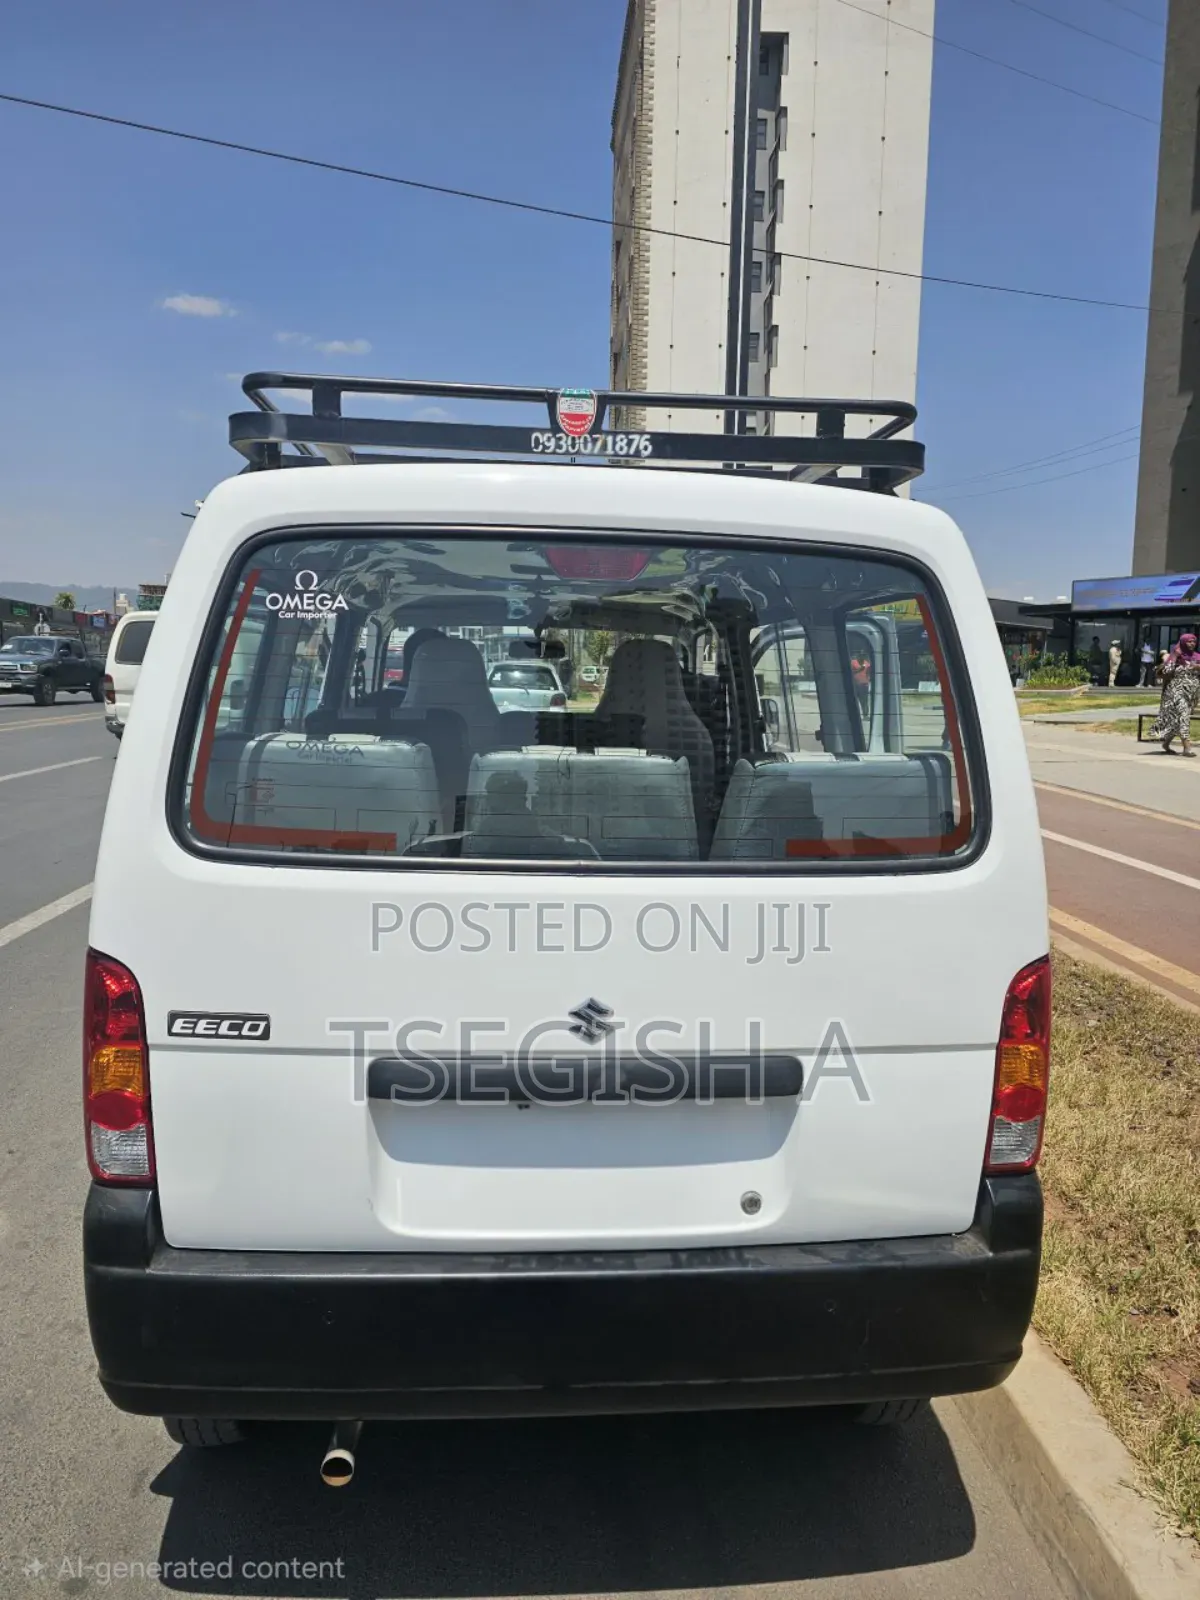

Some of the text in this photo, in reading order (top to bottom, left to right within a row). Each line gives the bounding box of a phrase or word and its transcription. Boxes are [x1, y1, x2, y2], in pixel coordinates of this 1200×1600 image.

[531, 432, 653, 457] 0930071876
[265, 592, 350, 611] OMEGA
[278, 610, 337, 620] Car Importer
[171, 1018, 268, 1036] EECO
